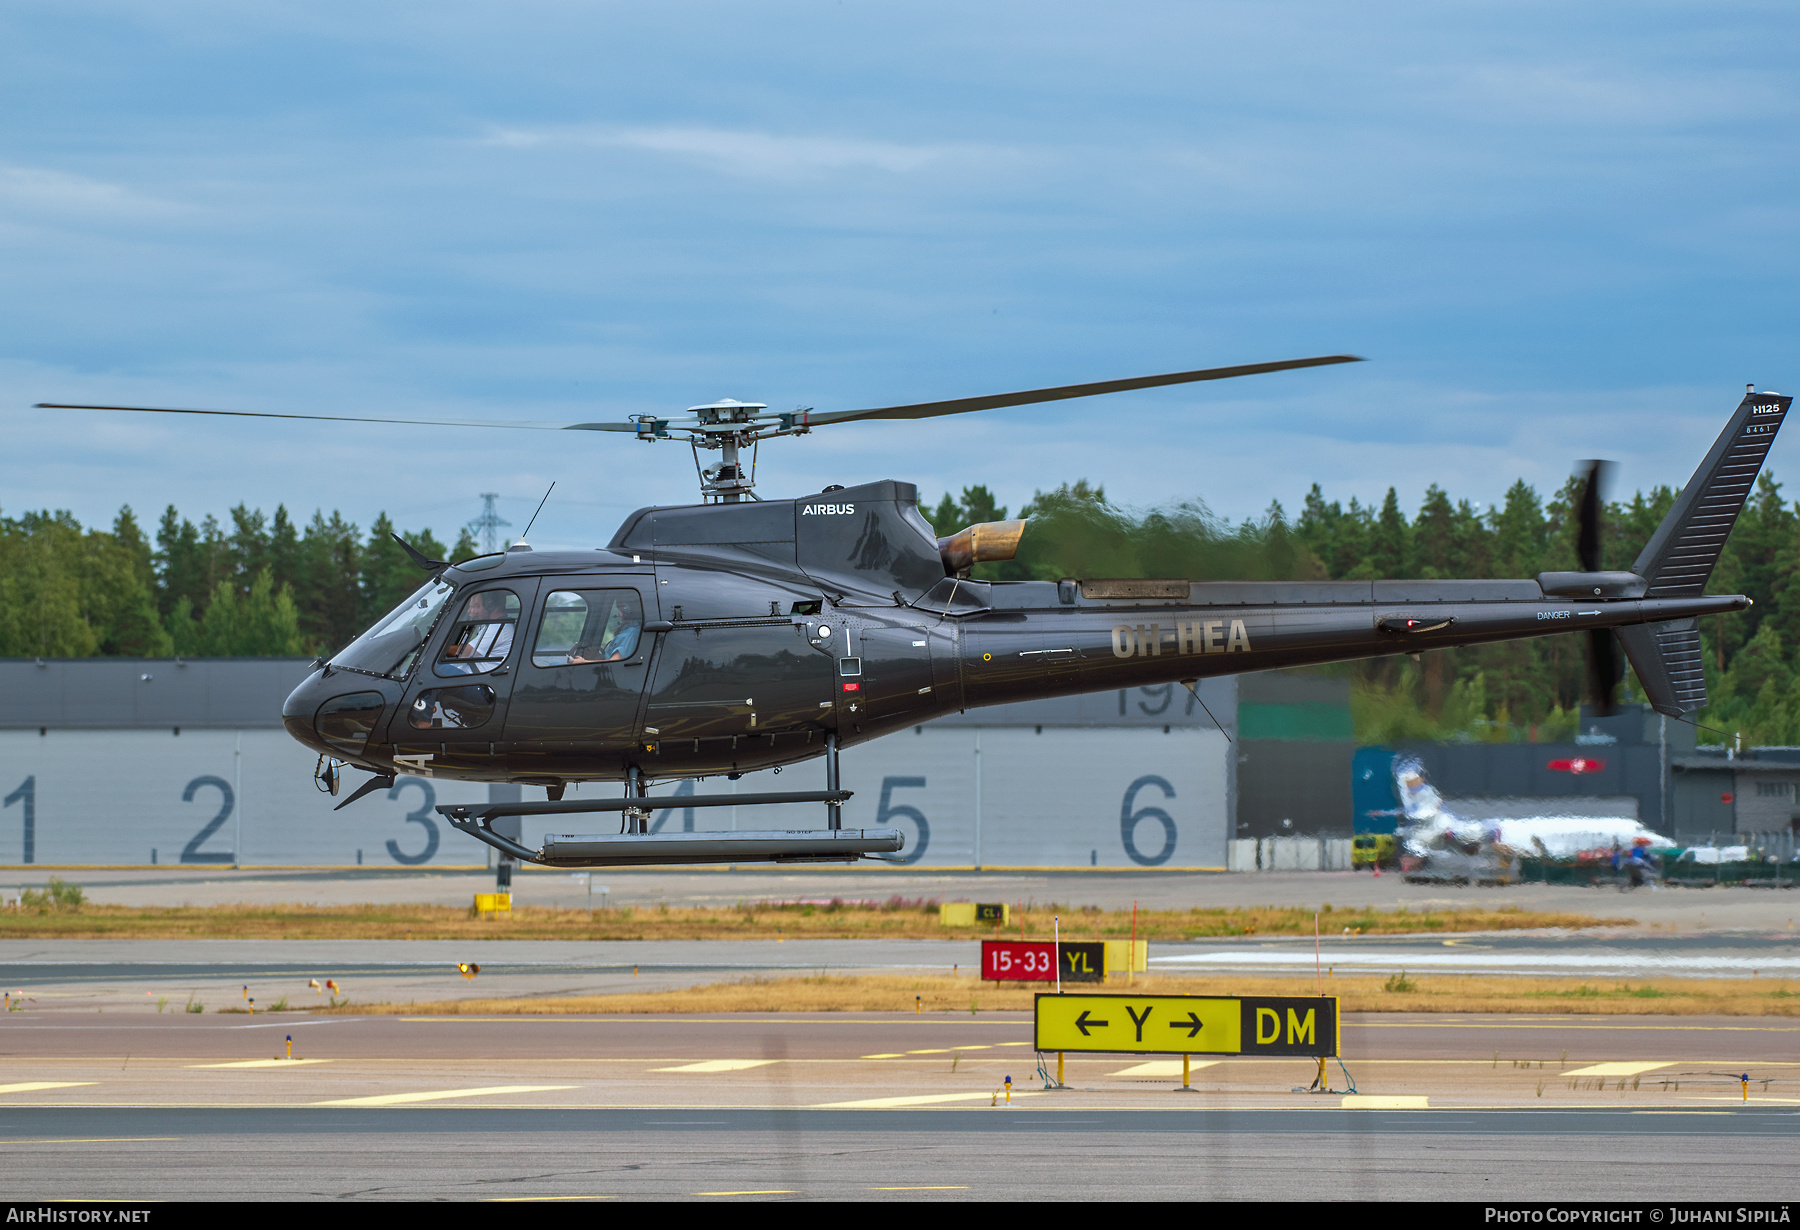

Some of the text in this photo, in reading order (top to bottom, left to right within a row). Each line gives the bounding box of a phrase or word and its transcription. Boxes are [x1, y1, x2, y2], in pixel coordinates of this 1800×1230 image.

[1752, 404, 1780, 414] H125
[802, 503, 855, 516] AIRBUS
[1537, 610, 1570, 620] DANGER
[1111, 619, 1252, 659] OH-HEA
[3, 775, 36, 864] 1
[180, 775, 236, 865] 2
[385, 776, 441, 866] 3
[876, 776, 931, 866] 5
[1120, 775, 1178, 867] 6
[982, 908, 995, 918] CL
[992, 951, 1094, 973] 15-33 YL
[1125, 1006, 1316, 1045] Y DM
